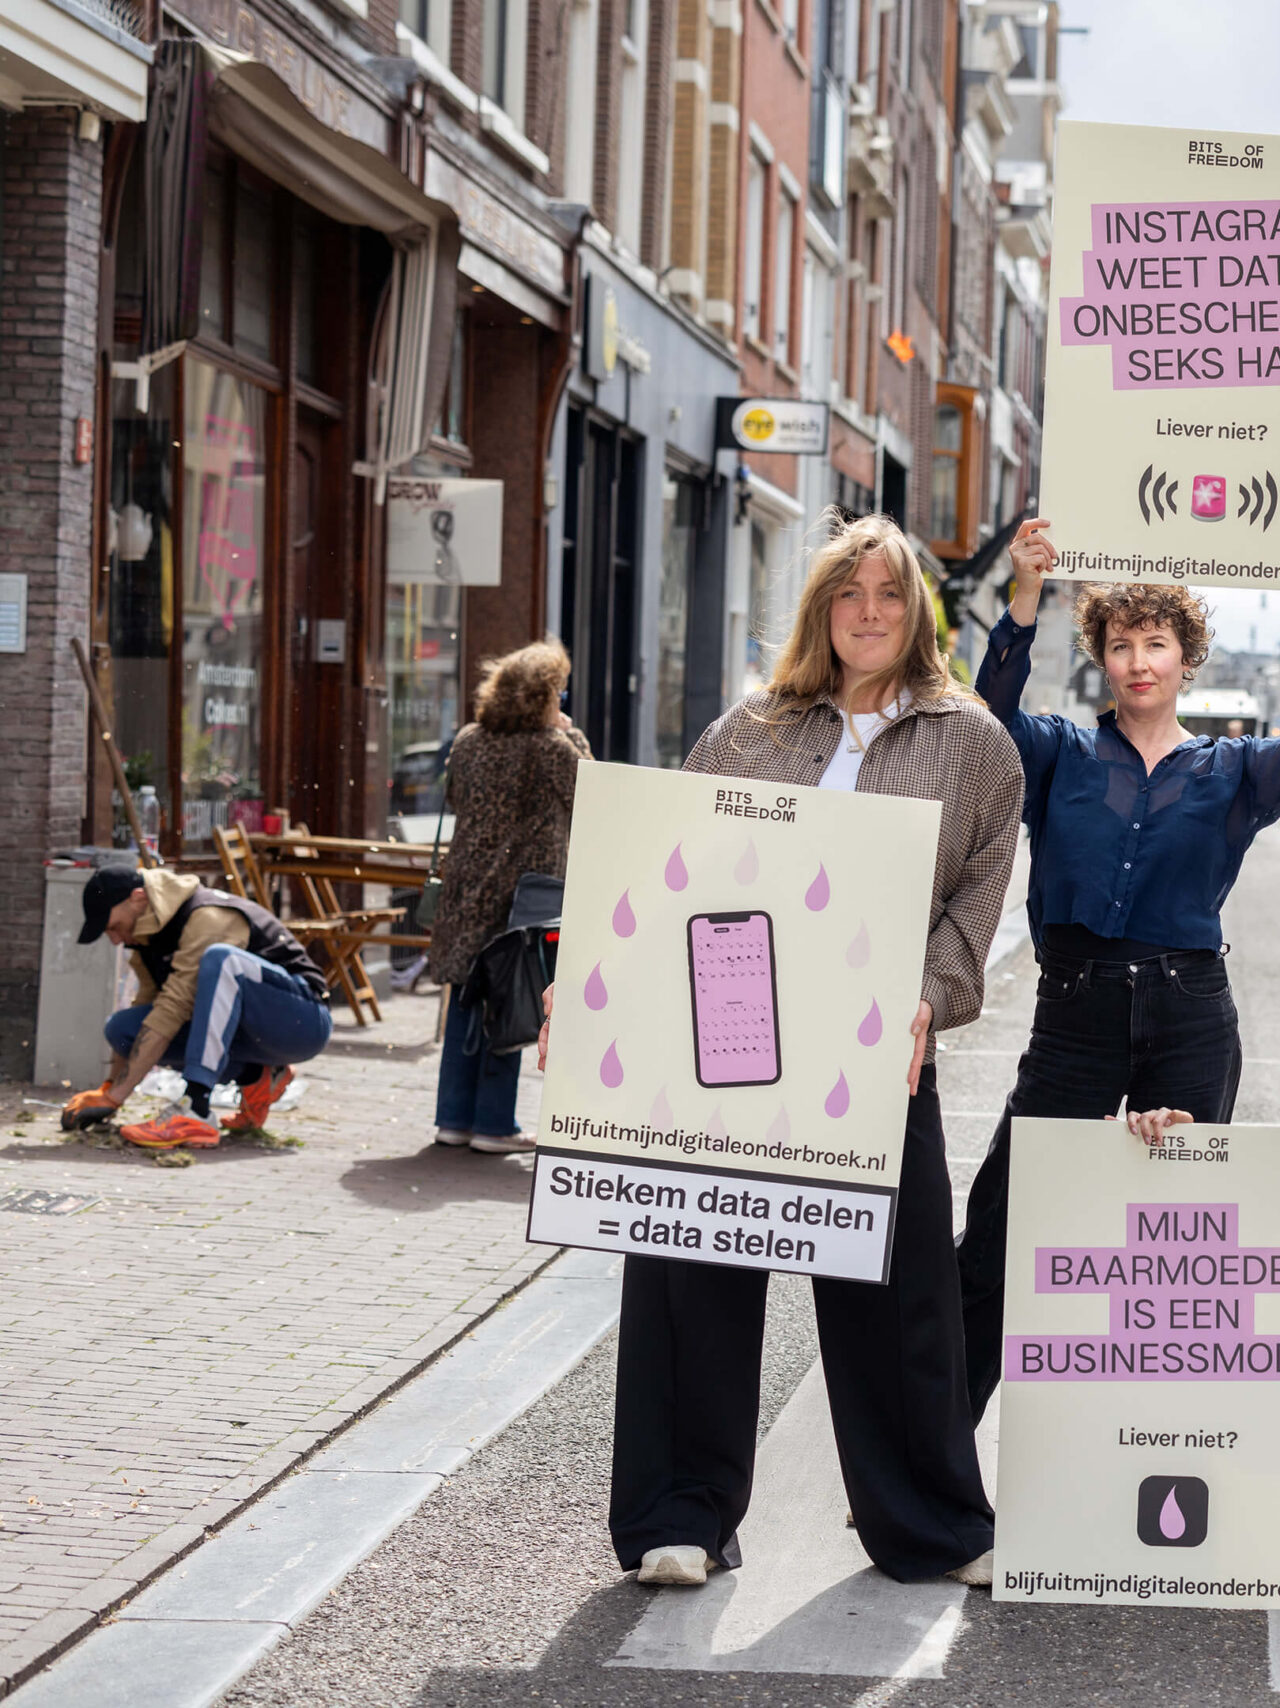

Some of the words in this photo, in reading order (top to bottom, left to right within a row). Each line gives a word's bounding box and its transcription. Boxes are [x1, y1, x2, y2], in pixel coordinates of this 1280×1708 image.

[1188, 140, 1223, 154] BITS
[1244, 144, 1264, 157] OF
[1188, 153, 1264, 169] FREEDOM
[1096, 256, 1208, 290] WEET
[1127, 347, 1225, 382] SEKS
[1156, 418, 1214, 439] Liever
[1218, 424, 1269, 442] niet?
[716, 789, 753, 805] BITS
[776, 796, 798, 809] OF
[714, 802, 796, 824] FREEDOM
[550, 1115, 887, 1172] blijfuitmijndigitaleonderbroek.nl
[1208, 1137, 1230, 1149] OF
[1149, 1148, 1229, 1163] FREEDOM
[549, 1166, 687, 1210] Stiekem
[697, 1186, 771, 1221] data
[780, 1195, 875, 1232] delen
[1136, 1211, 1228, 1242] MIJN
[628, 1215, 703, 1250] data
[711, 1227, 817, 1263] stelen
[1123, 1299, 1157, 1330] IS
[1168, 1299, 1240, 1330] EEN
[1118, 1427, 1180, 1447] Liever
[1184, 1431, 1239, 1449] niet?
